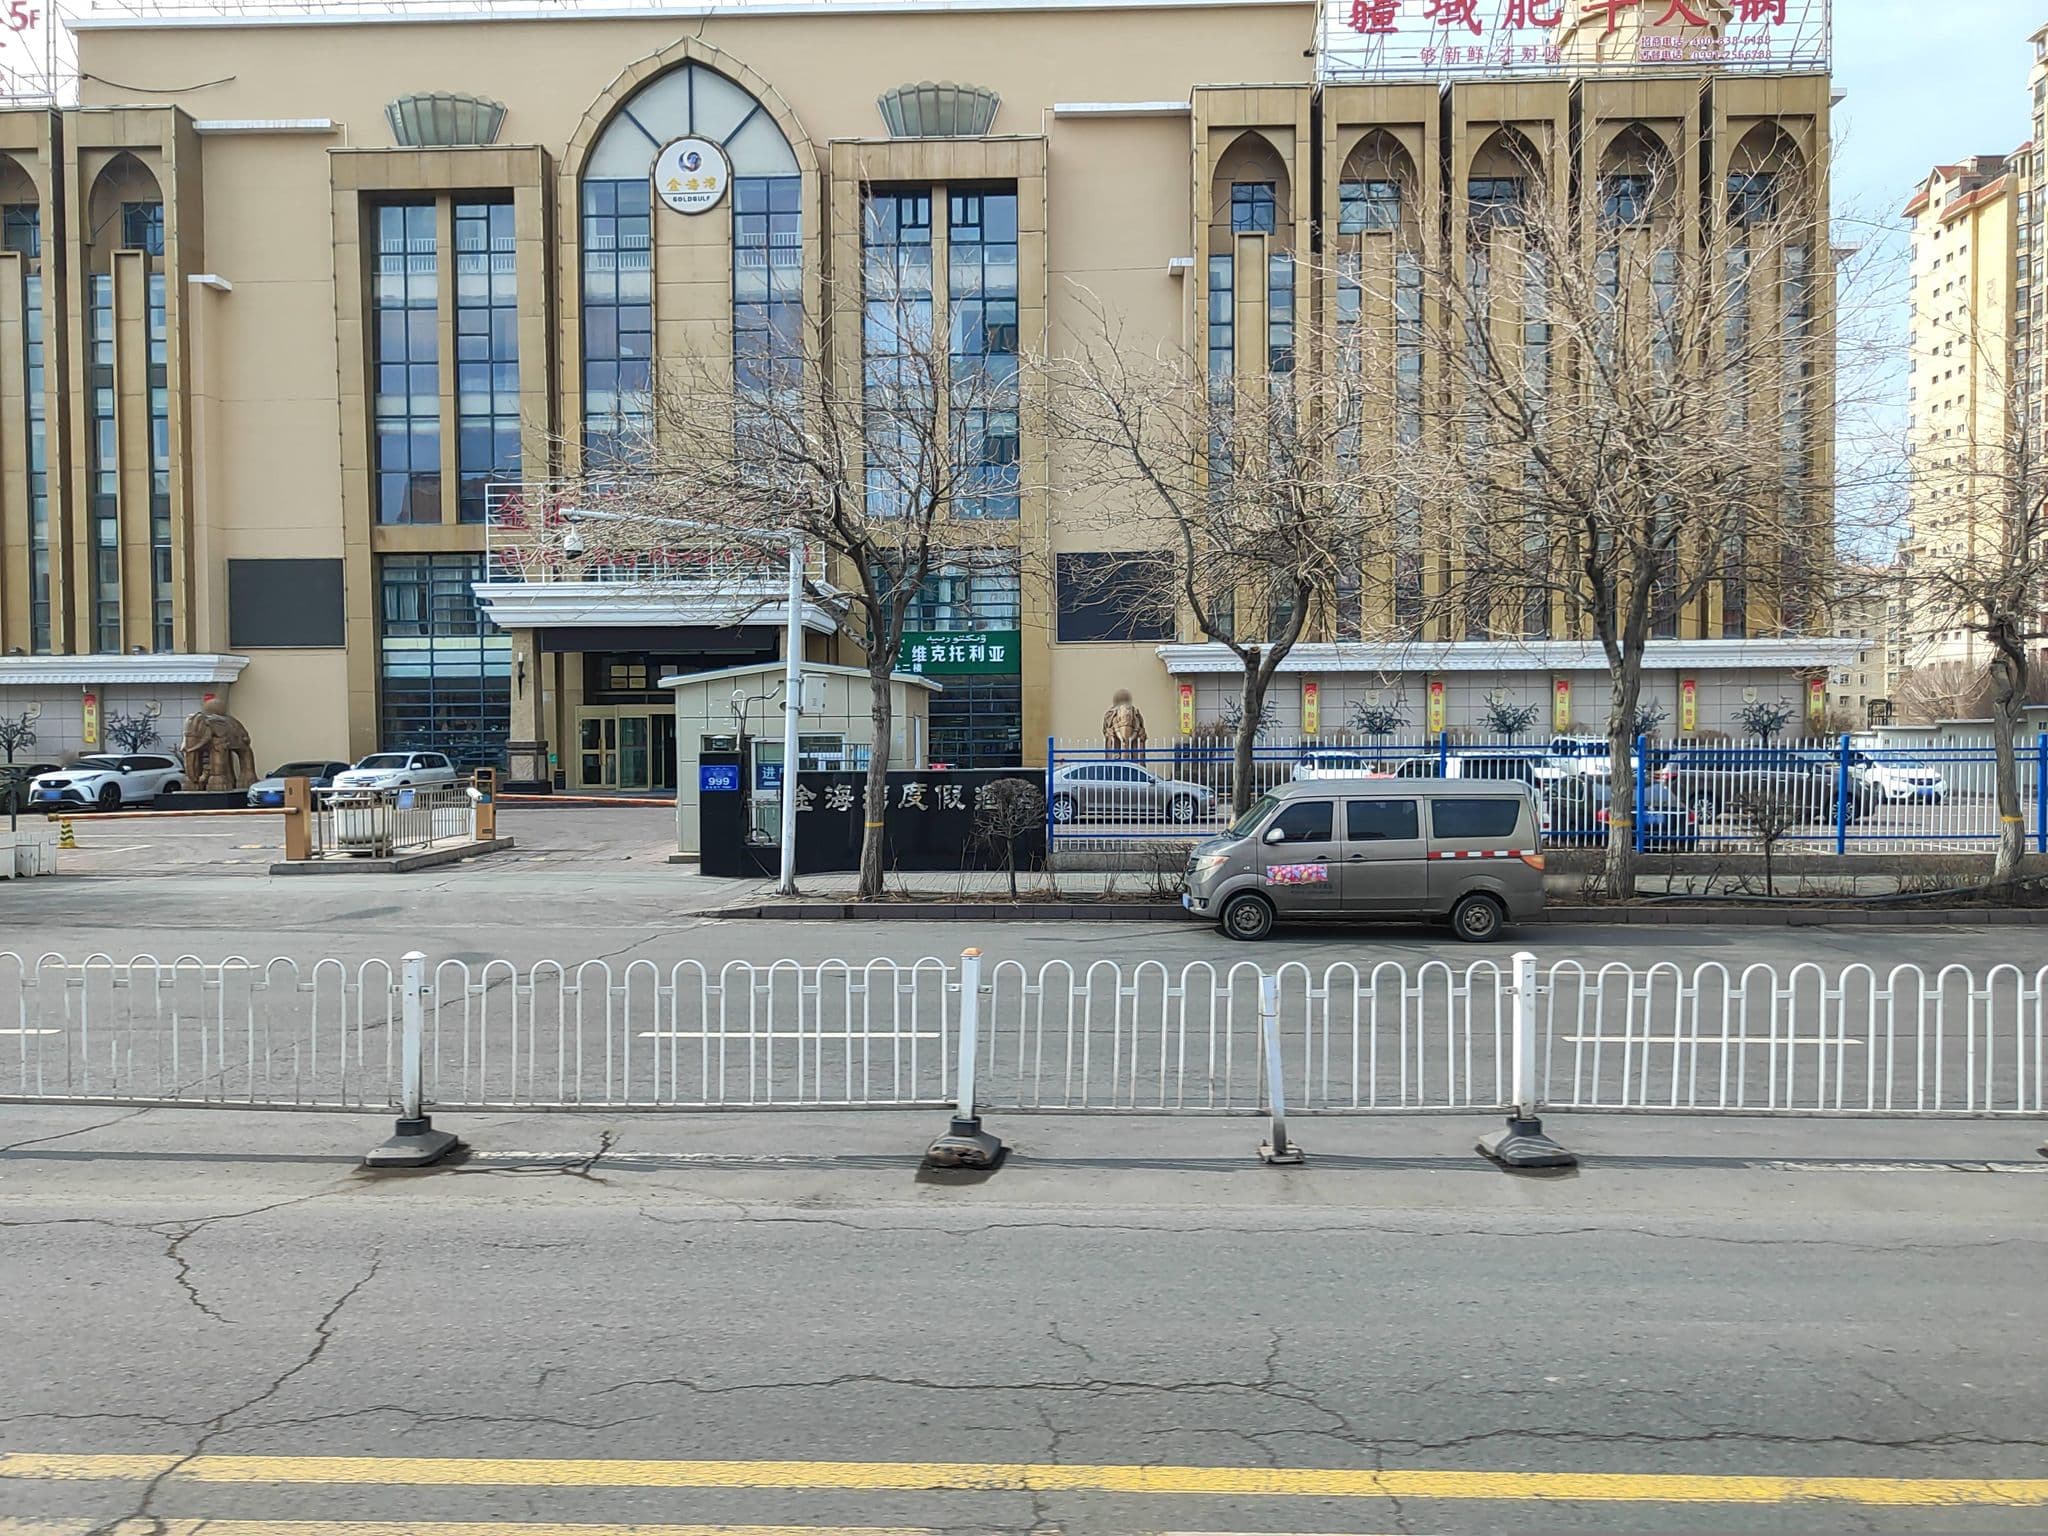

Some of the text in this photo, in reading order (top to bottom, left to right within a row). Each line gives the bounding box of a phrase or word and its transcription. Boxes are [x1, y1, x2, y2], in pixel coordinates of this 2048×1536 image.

[911, 645, 1006, 663] 维克托利亚
[707, 776, 730, 786] 999
